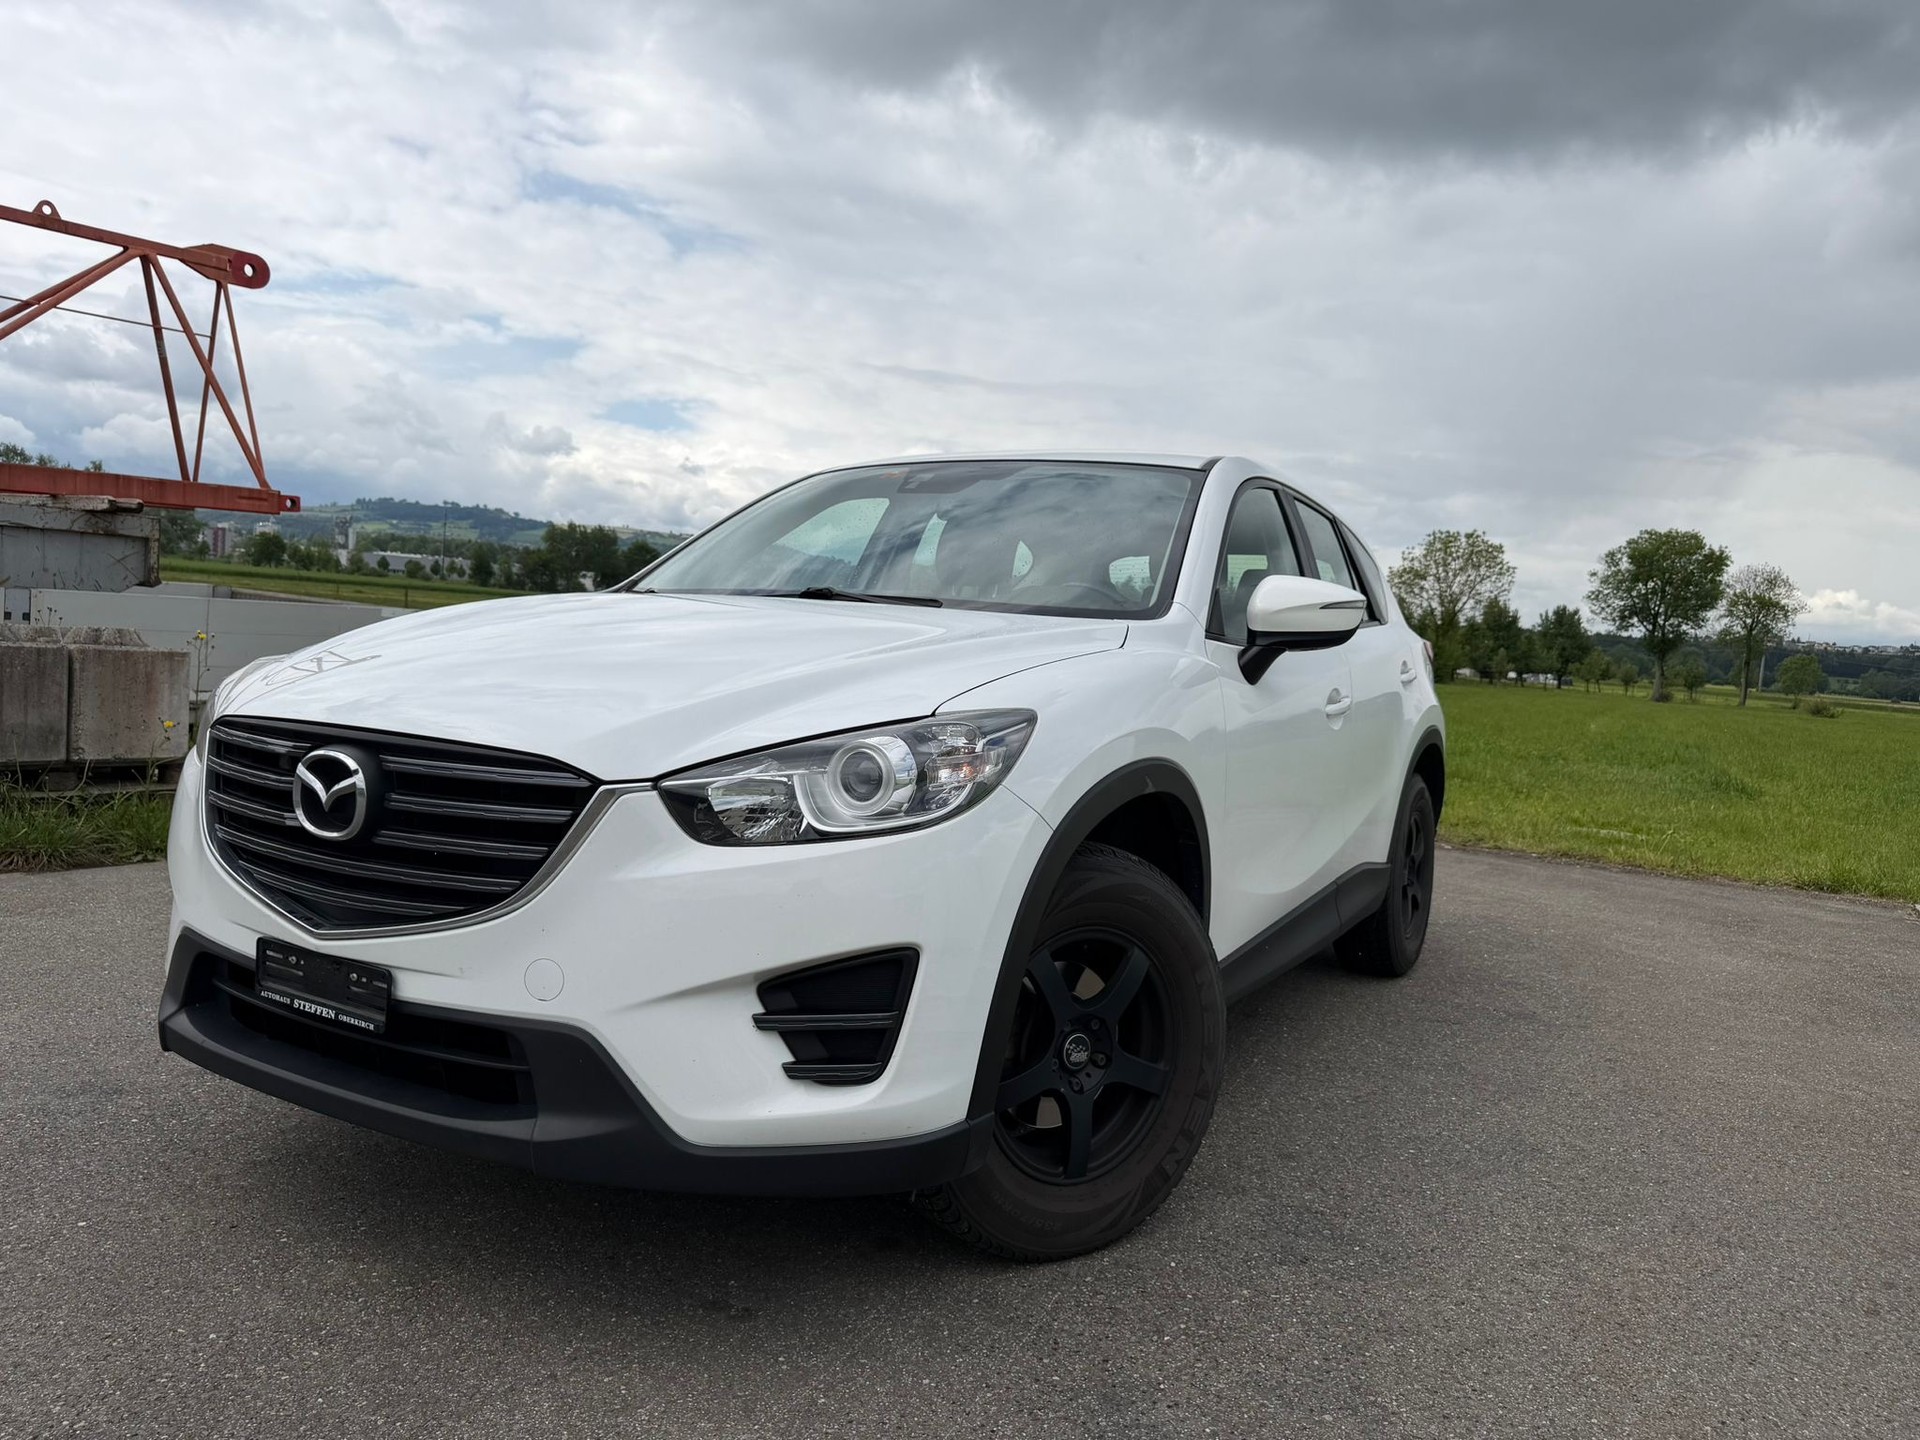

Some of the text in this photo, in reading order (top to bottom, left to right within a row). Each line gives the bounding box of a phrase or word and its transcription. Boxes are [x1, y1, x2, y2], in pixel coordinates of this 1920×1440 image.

[260, 990, 375, 1031] AUTOHAUS STEFFEN OBERKIRCH
